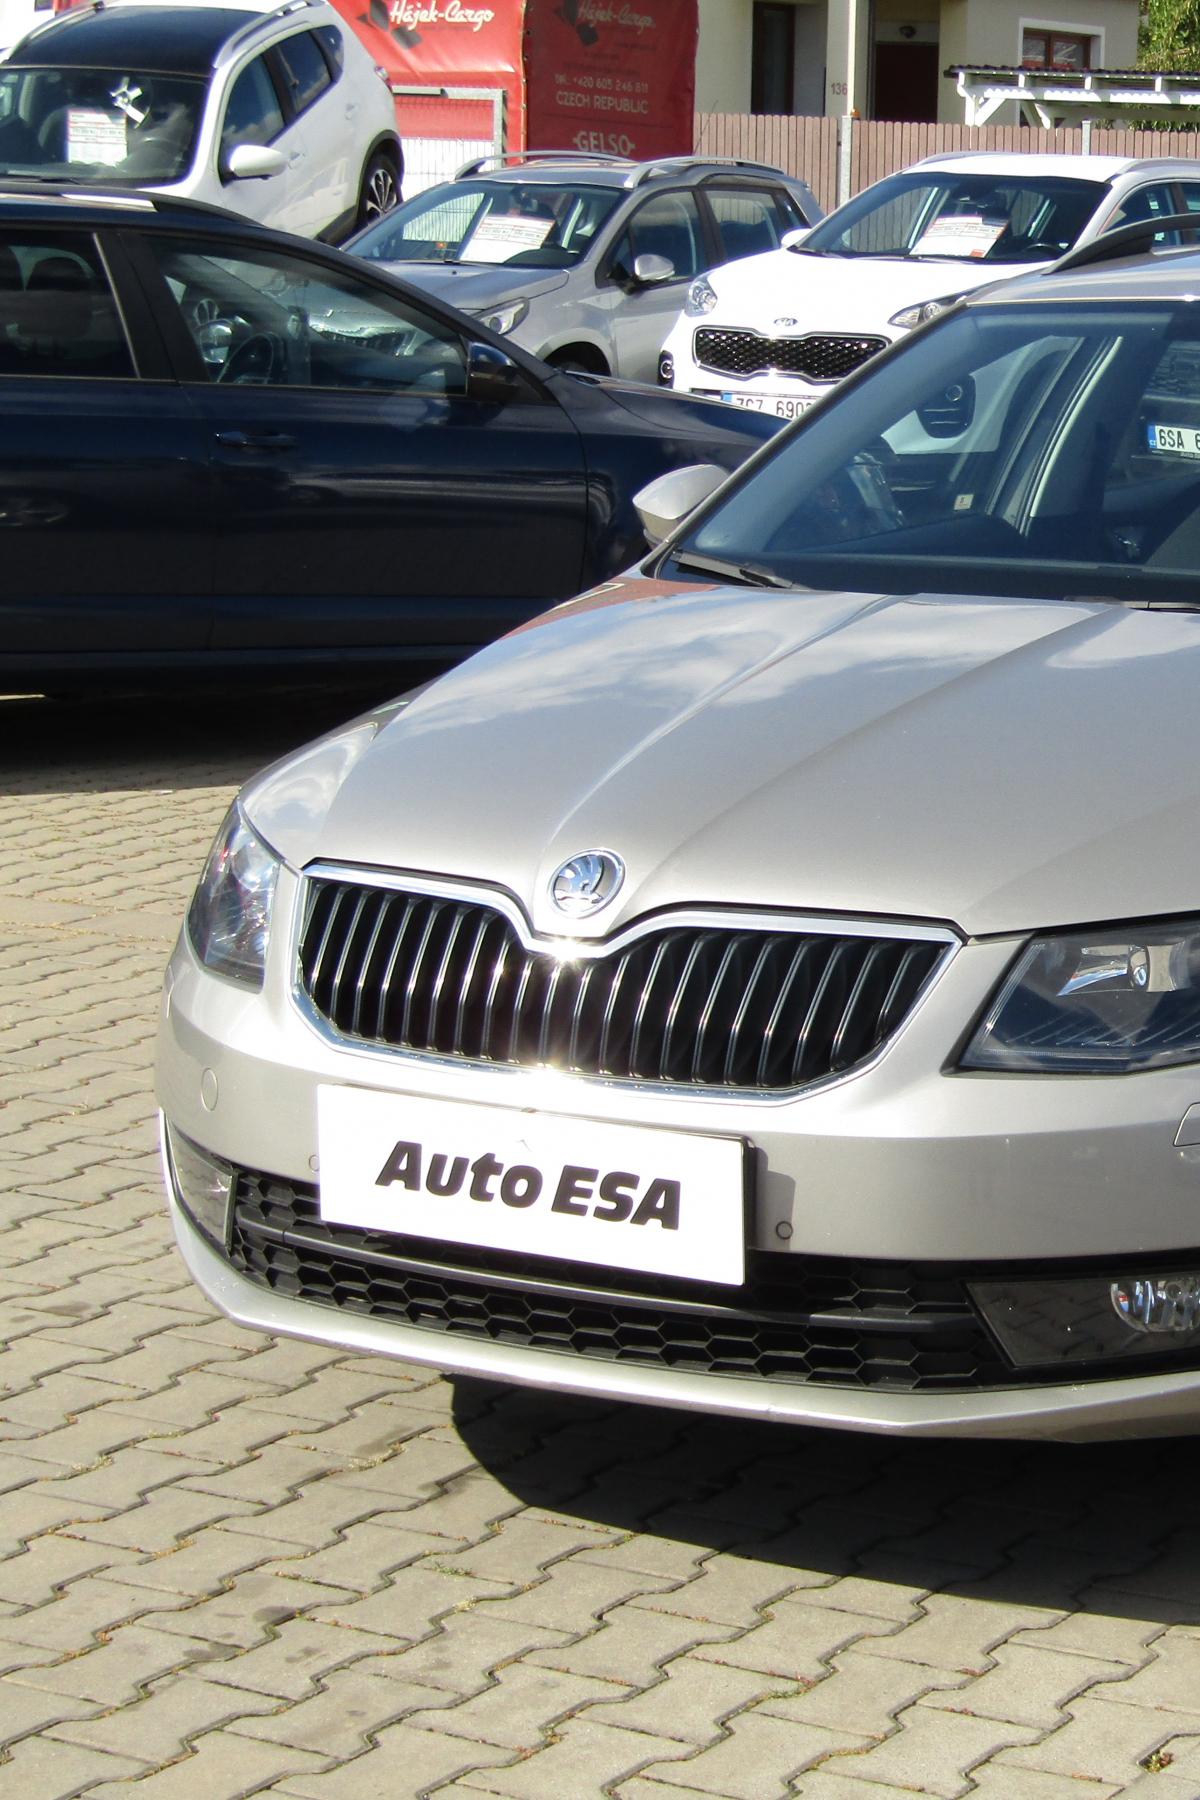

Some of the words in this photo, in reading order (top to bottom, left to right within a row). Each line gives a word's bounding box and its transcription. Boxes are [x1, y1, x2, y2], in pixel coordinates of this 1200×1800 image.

[390, 0, 495, 32] Hájek-Cargo
[830, 82, 848, 96] 136
[556, 91, 591, 108] CZECH
[593, 95, 649, 115] REPUBLIC
[775, 400, 812, 418] 690
[1158, 428, 1185, 449] 6SA
[375, 1140, 544, 1209] Auto
[551, 1164, 681, 1231] ESA
